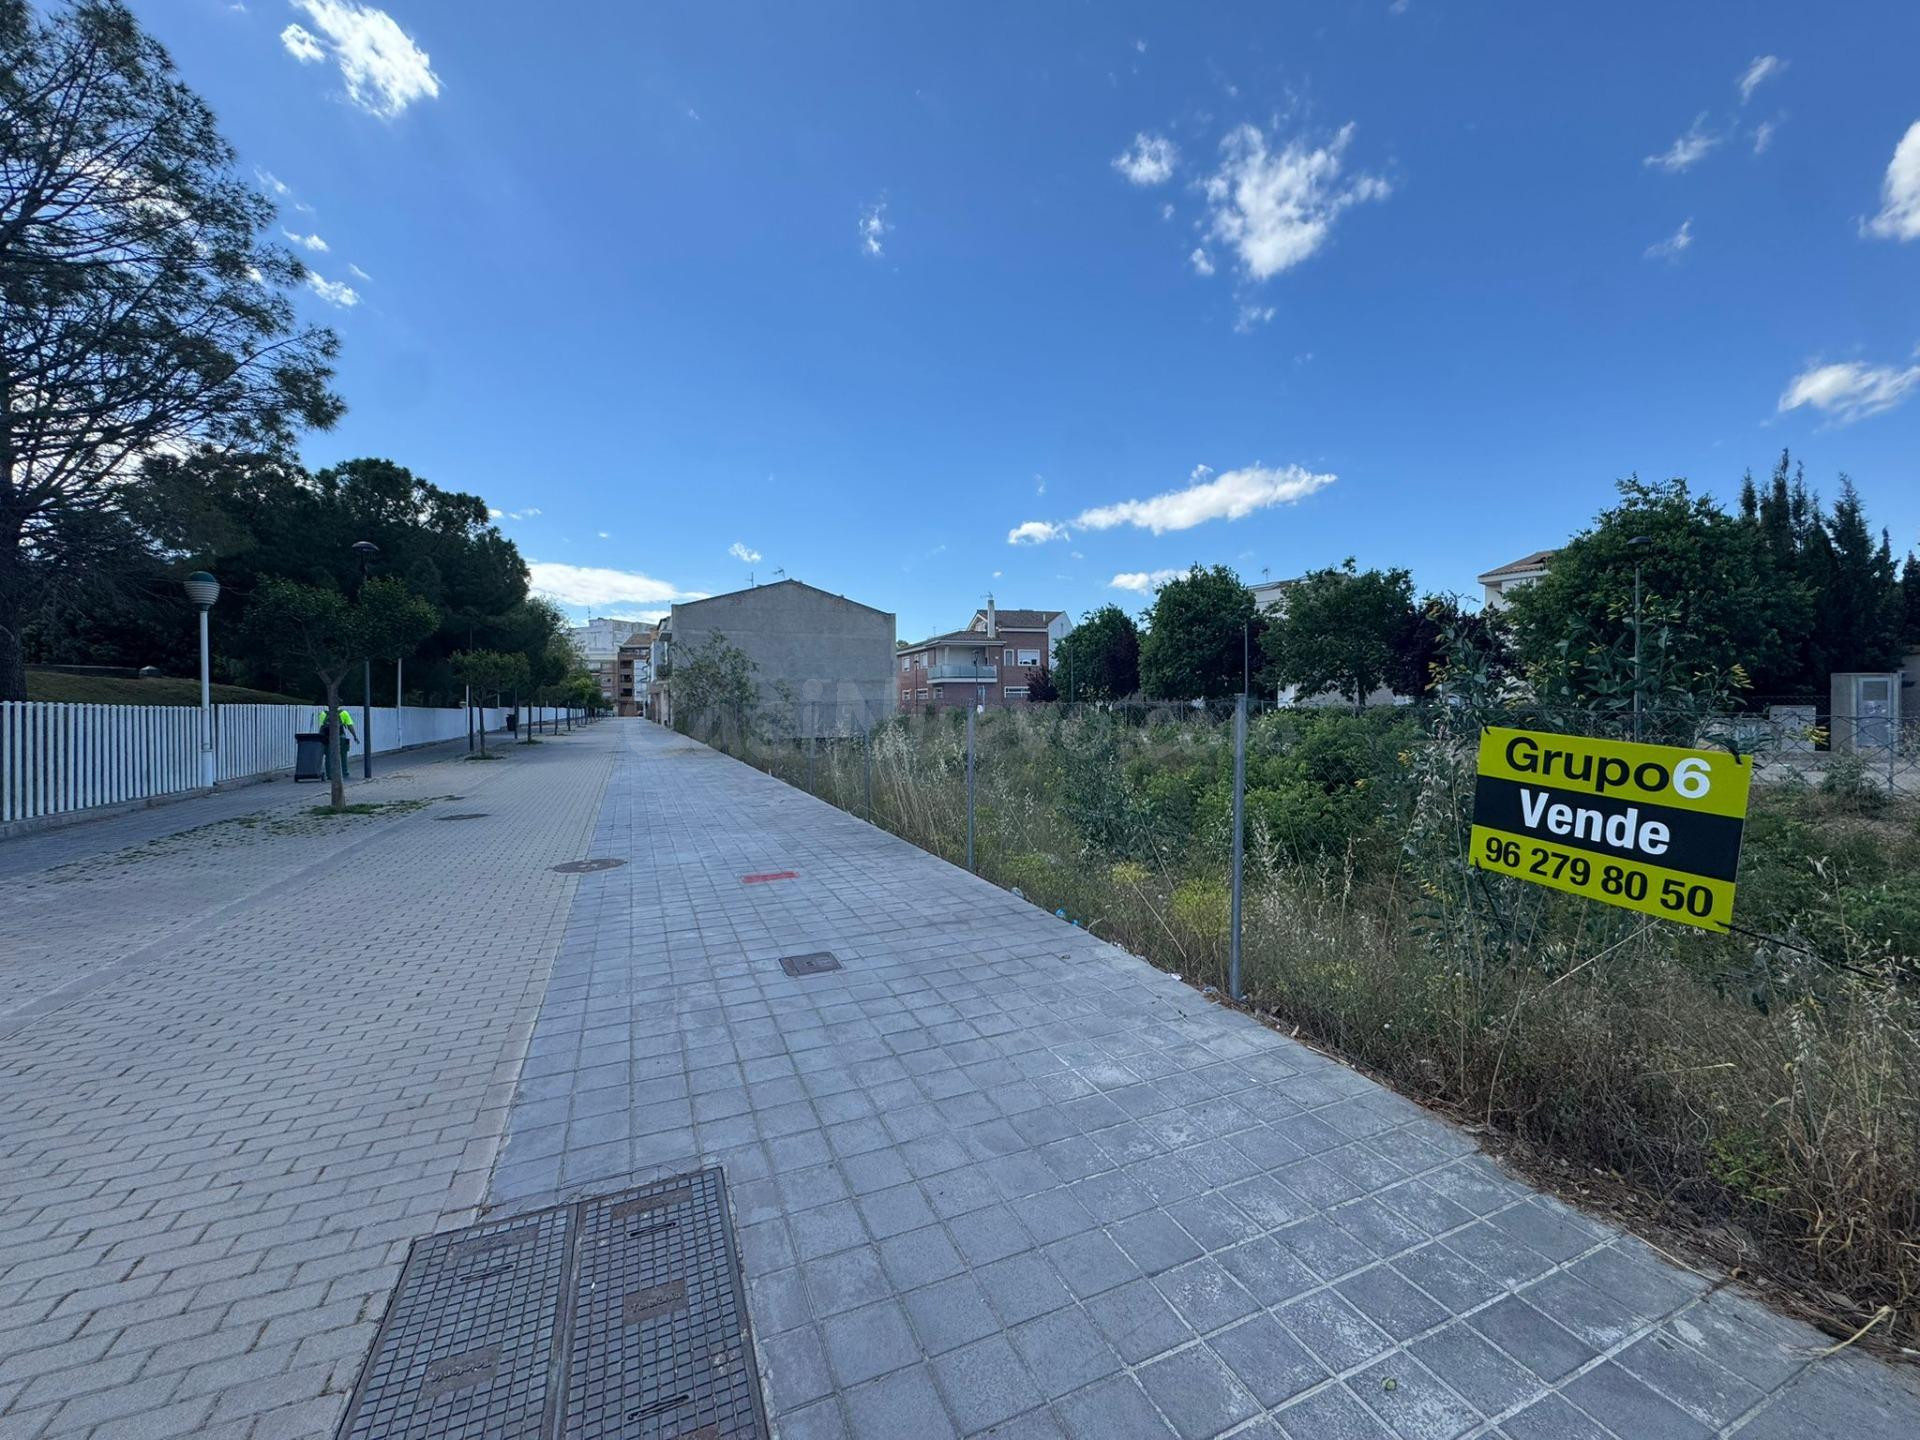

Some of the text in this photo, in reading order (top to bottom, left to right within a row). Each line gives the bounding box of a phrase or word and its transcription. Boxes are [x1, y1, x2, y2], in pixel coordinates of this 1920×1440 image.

[1504, 736, 1712, 799] Grupo6
[1519, 788, 1670, 855] Vende
[1485, 836, 1714, 919] 96 279 80 50
